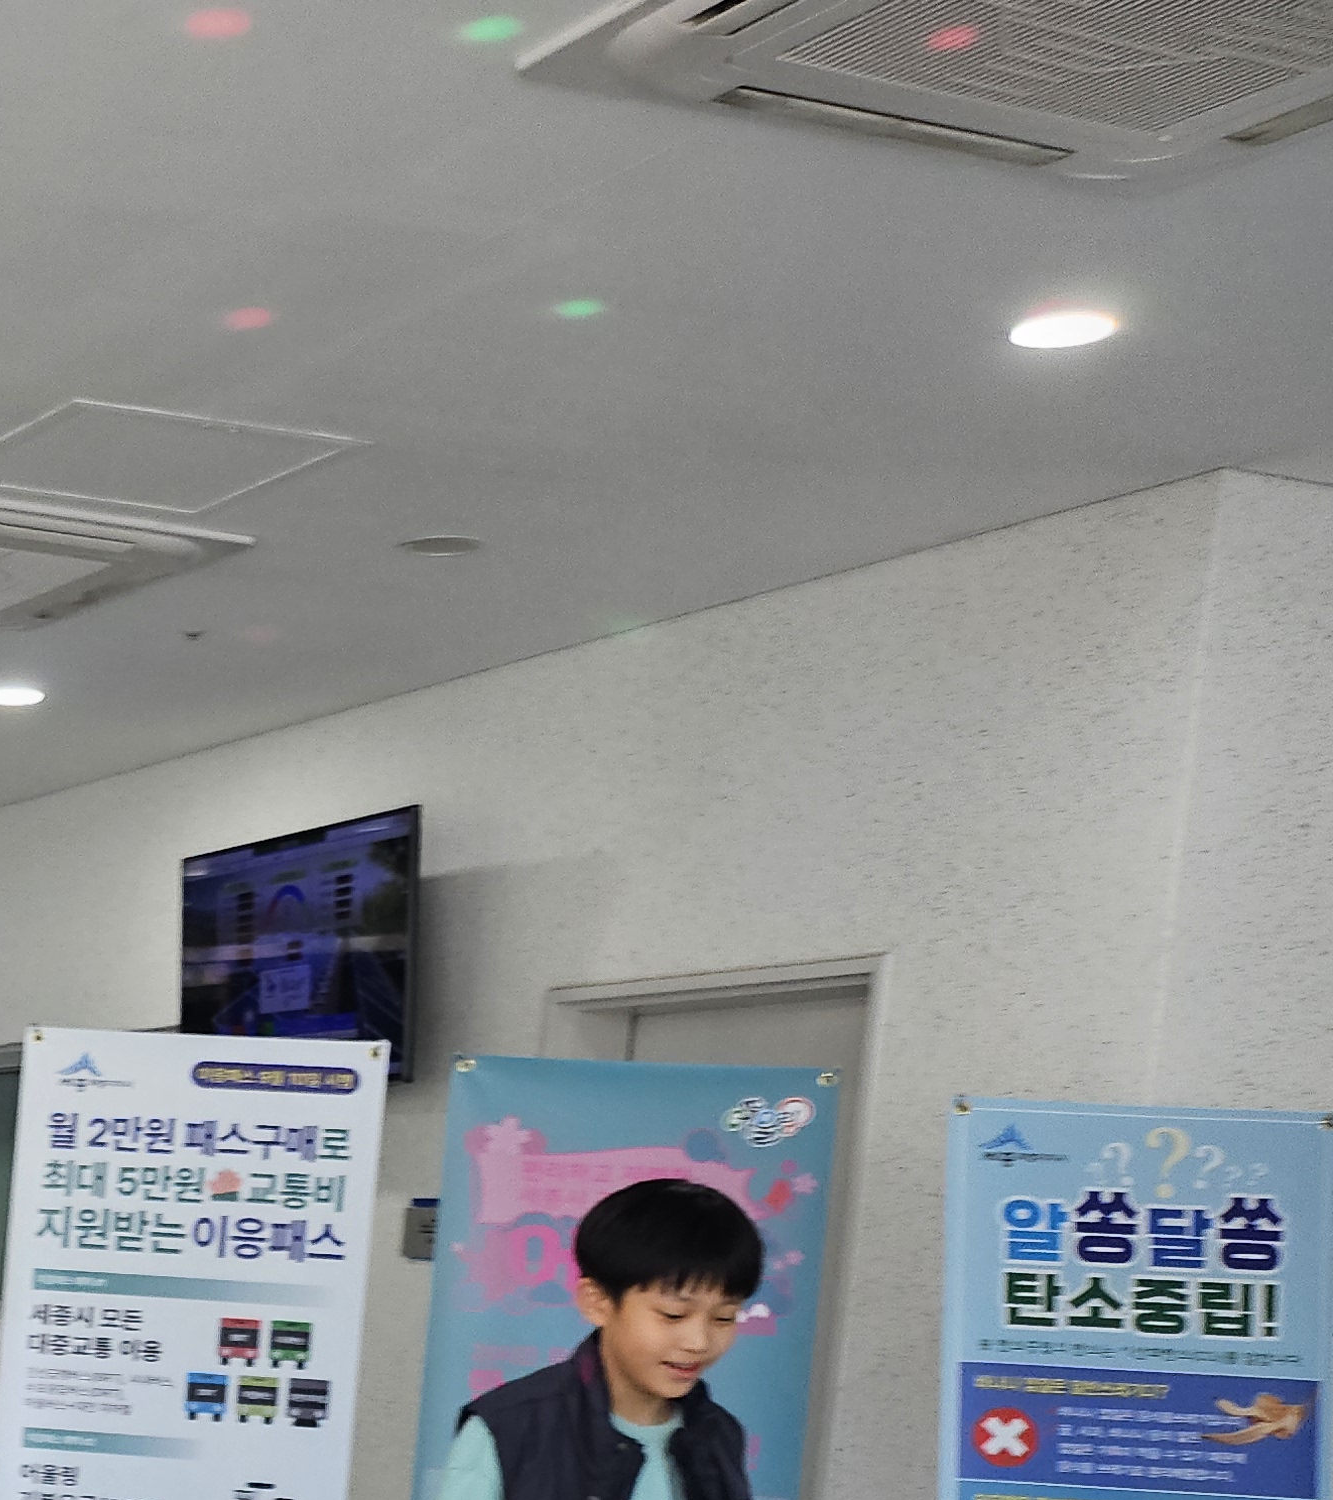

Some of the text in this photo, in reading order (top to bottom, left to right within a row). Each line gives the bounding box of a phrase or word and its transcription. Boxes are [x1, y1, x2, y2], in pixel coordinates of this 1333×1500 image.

[46, 1111, 351, 1162] 월 2만원 패스구매로
[42, 1159, 347, 1213] 최대 5만원 교통비
[35, 1206, 346, 1264] 지원받는 이응패스
[1002, 1188, 1283, 1271] 알쏭달쏭
[29, 1303, 145, 1331] 세종시 모든
[1005, 1270, 1276, 1338] 탄소중립!
[28, 1333, 164, 1363] 대중교통 이용
[19, 1463, 80, 1487] 어울링
